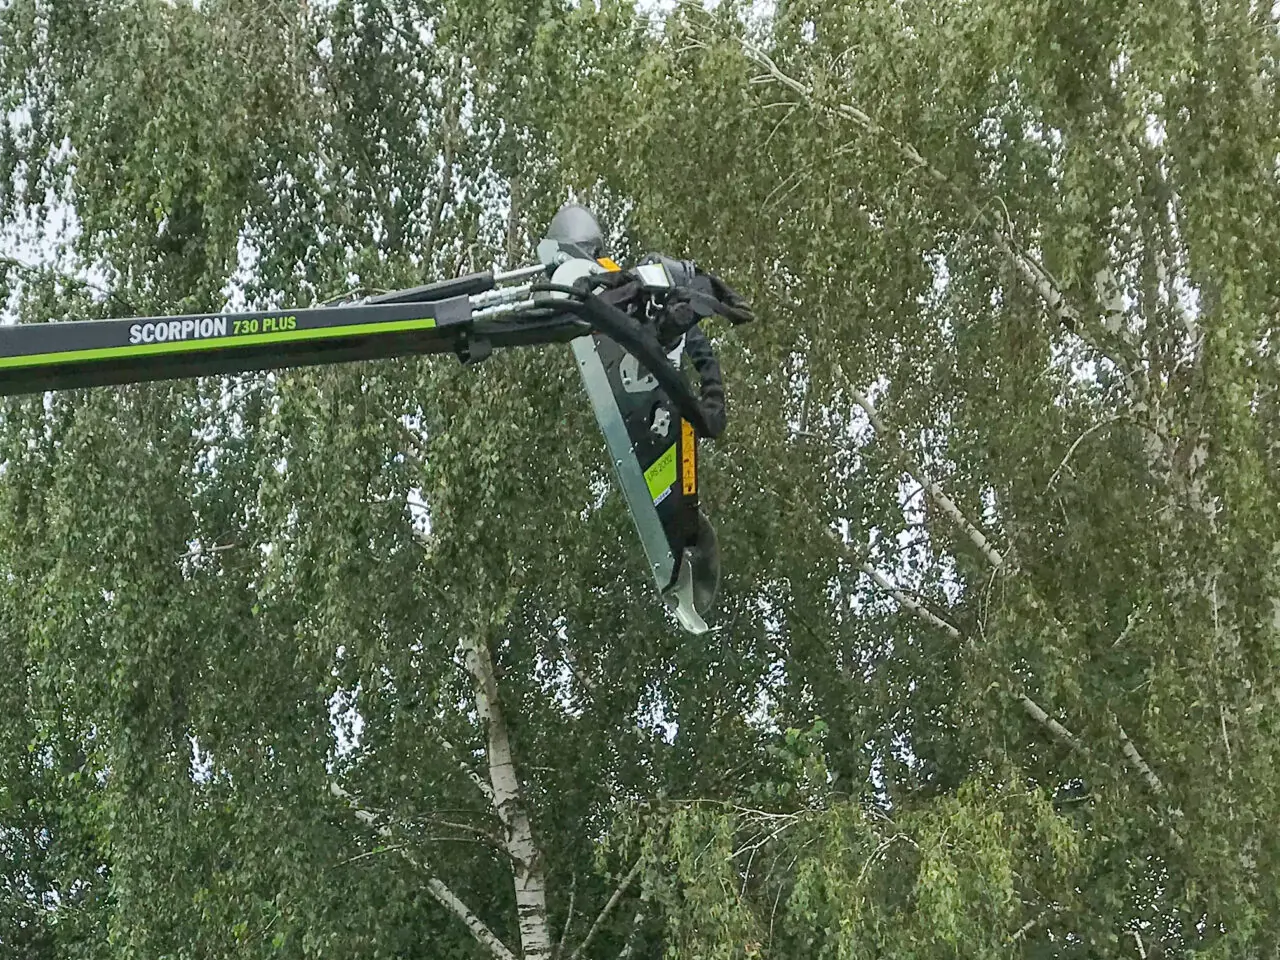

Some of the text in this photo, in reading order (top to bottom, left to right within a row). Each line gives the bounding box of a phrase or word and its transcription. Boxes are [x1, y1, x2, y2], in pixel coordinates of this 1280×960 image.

[129, 316, 297, 344] SCORPION 730 PLUS
